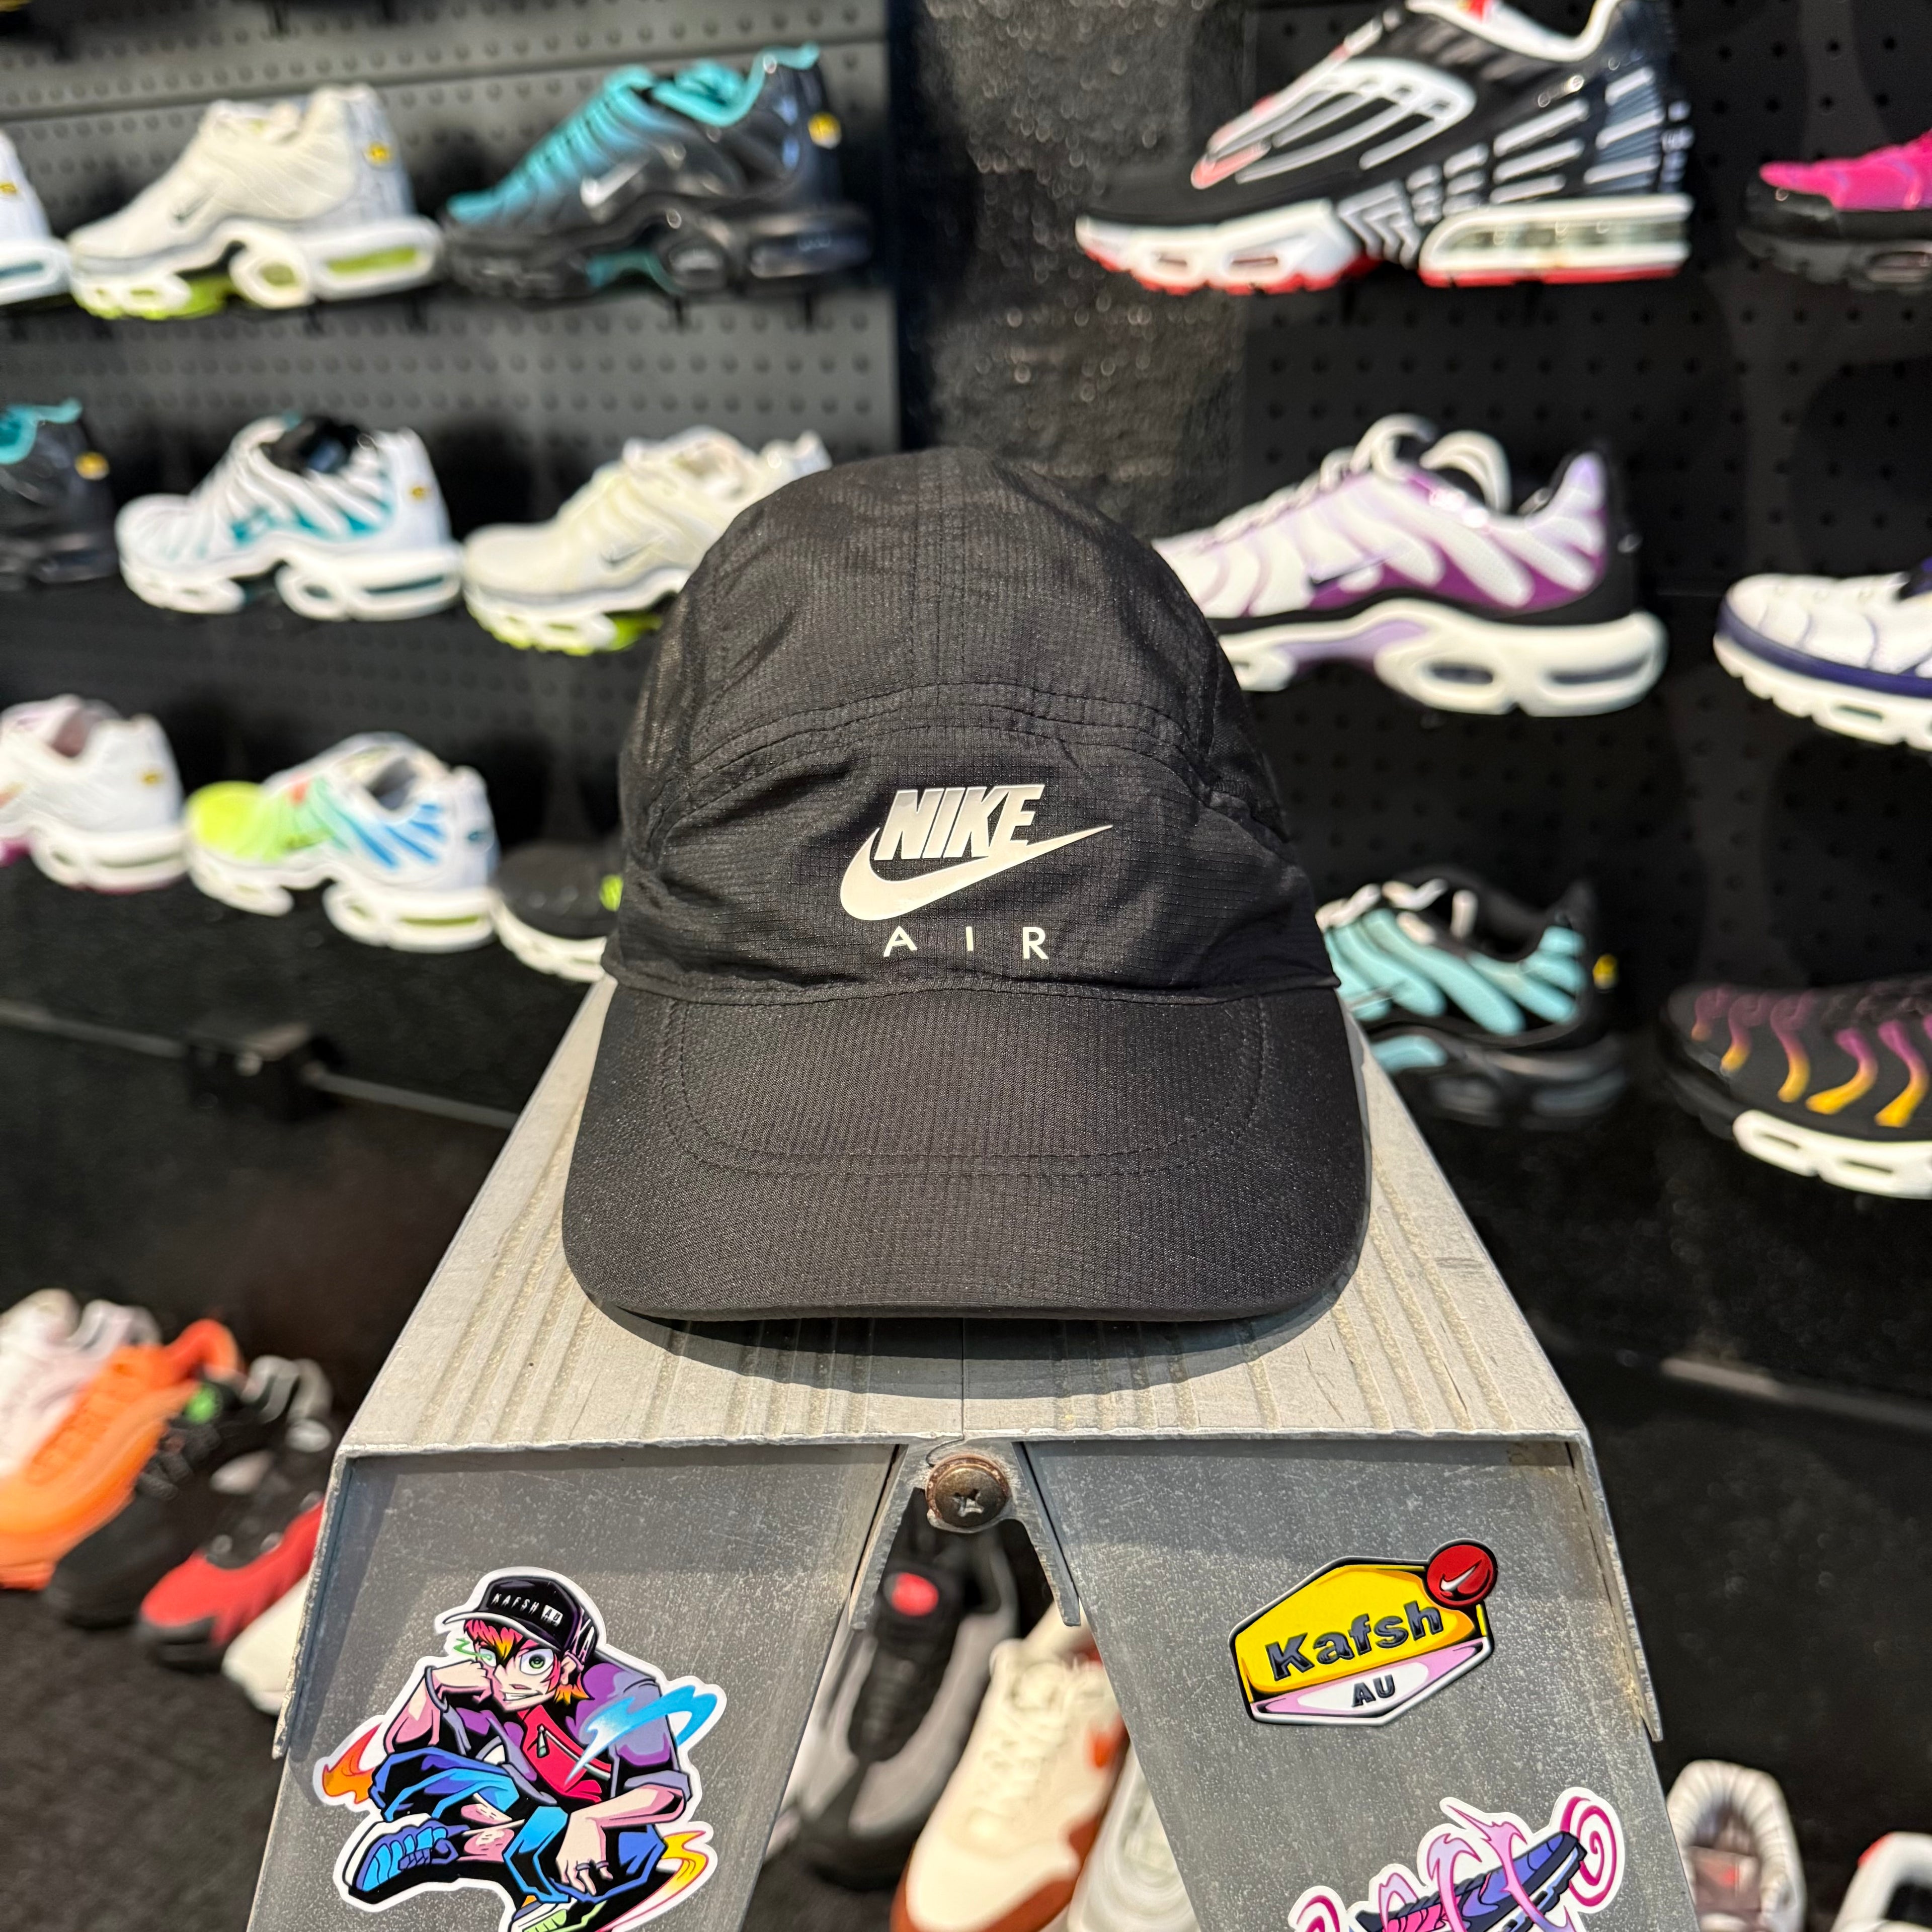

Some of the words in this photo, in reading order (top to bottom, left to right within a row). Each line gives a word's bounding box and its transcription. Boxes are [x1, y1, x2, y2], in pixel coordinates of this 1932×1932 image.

[874, 784, 1044, 861] NIKE
[883, 926, 1048, 959] AIR
[492, 1593, 539, 1615] KAFSH
[544, 1608, 562, 1622] AU
[1265, 1600, 1443, 1681] Kafsh
[1352, 1674, 1396, 1707] AU
